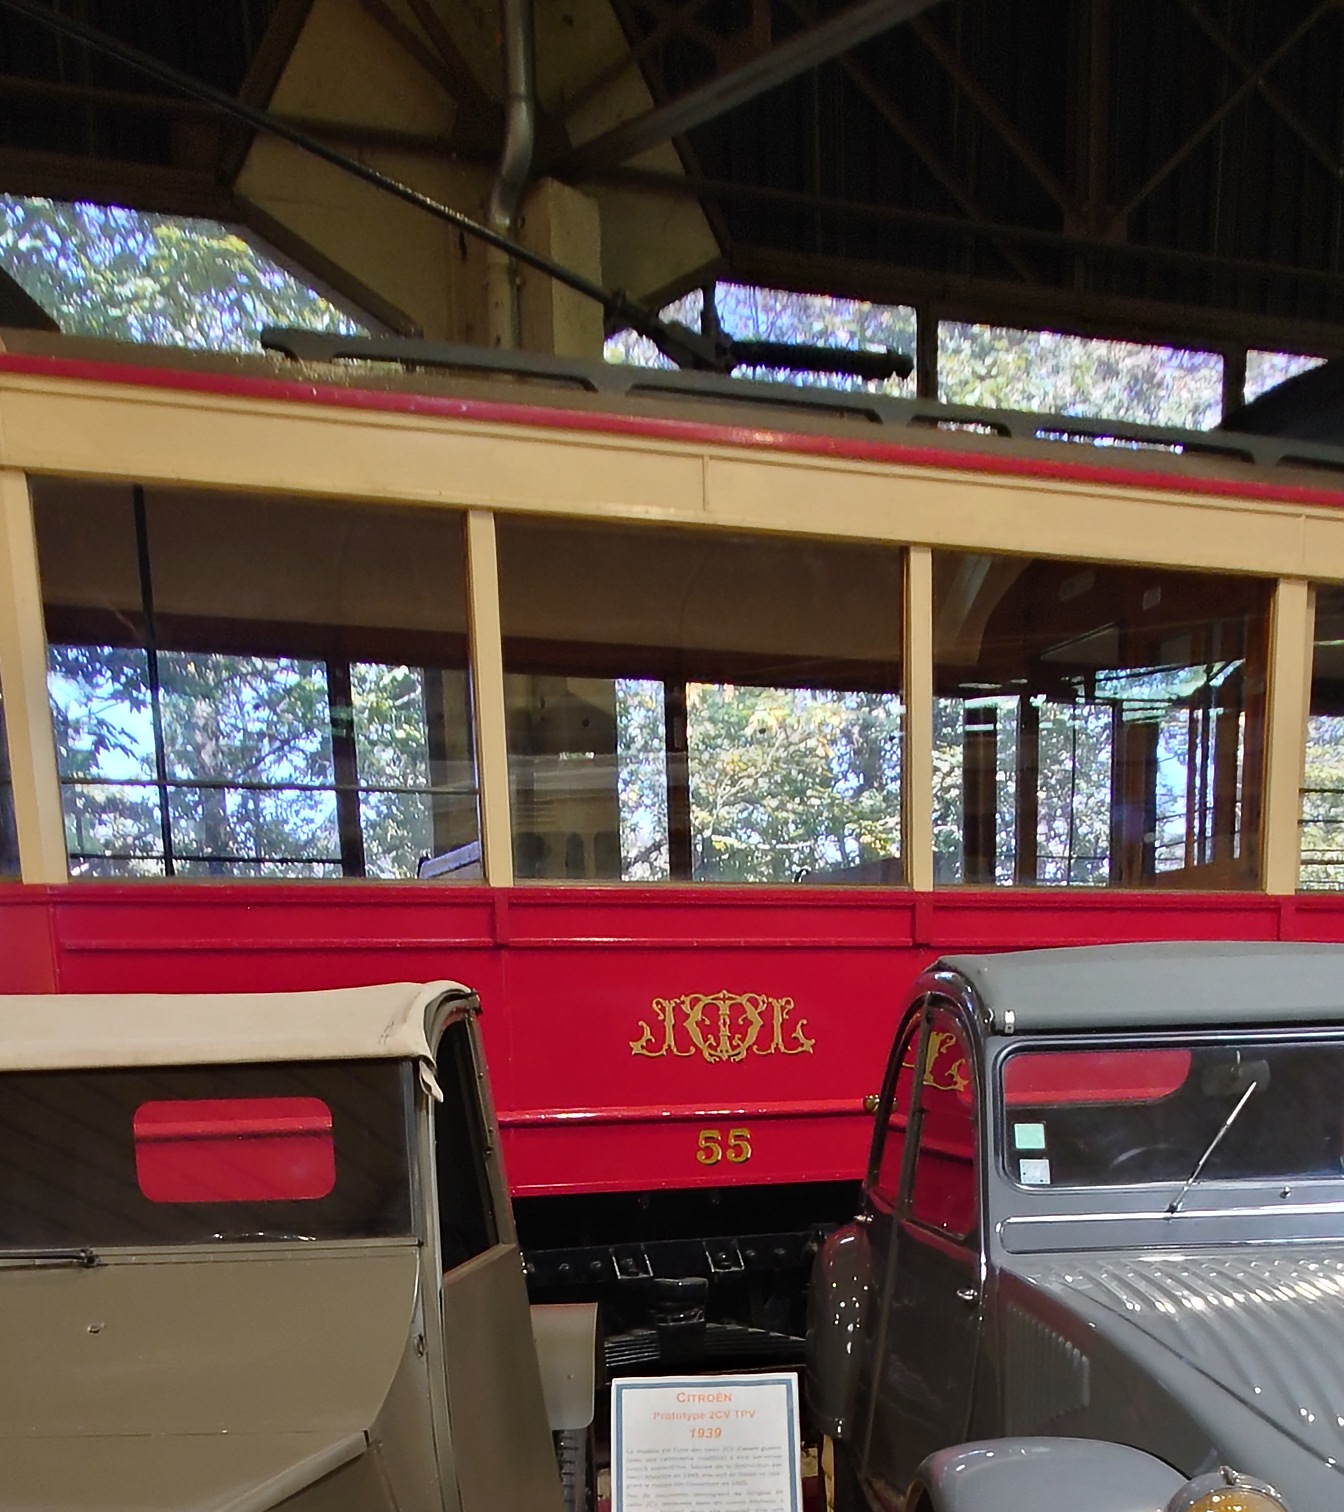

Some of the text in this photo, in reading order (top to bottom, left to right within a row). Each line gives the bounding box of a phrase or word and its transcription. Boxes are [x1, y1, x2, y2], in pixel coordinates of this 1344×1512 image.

[696, 1127, 752, 1166] 55
[653, 1409, 756, 1421] Prototype 2CV TPV
[689, 1426, 722, 1439] 1939
